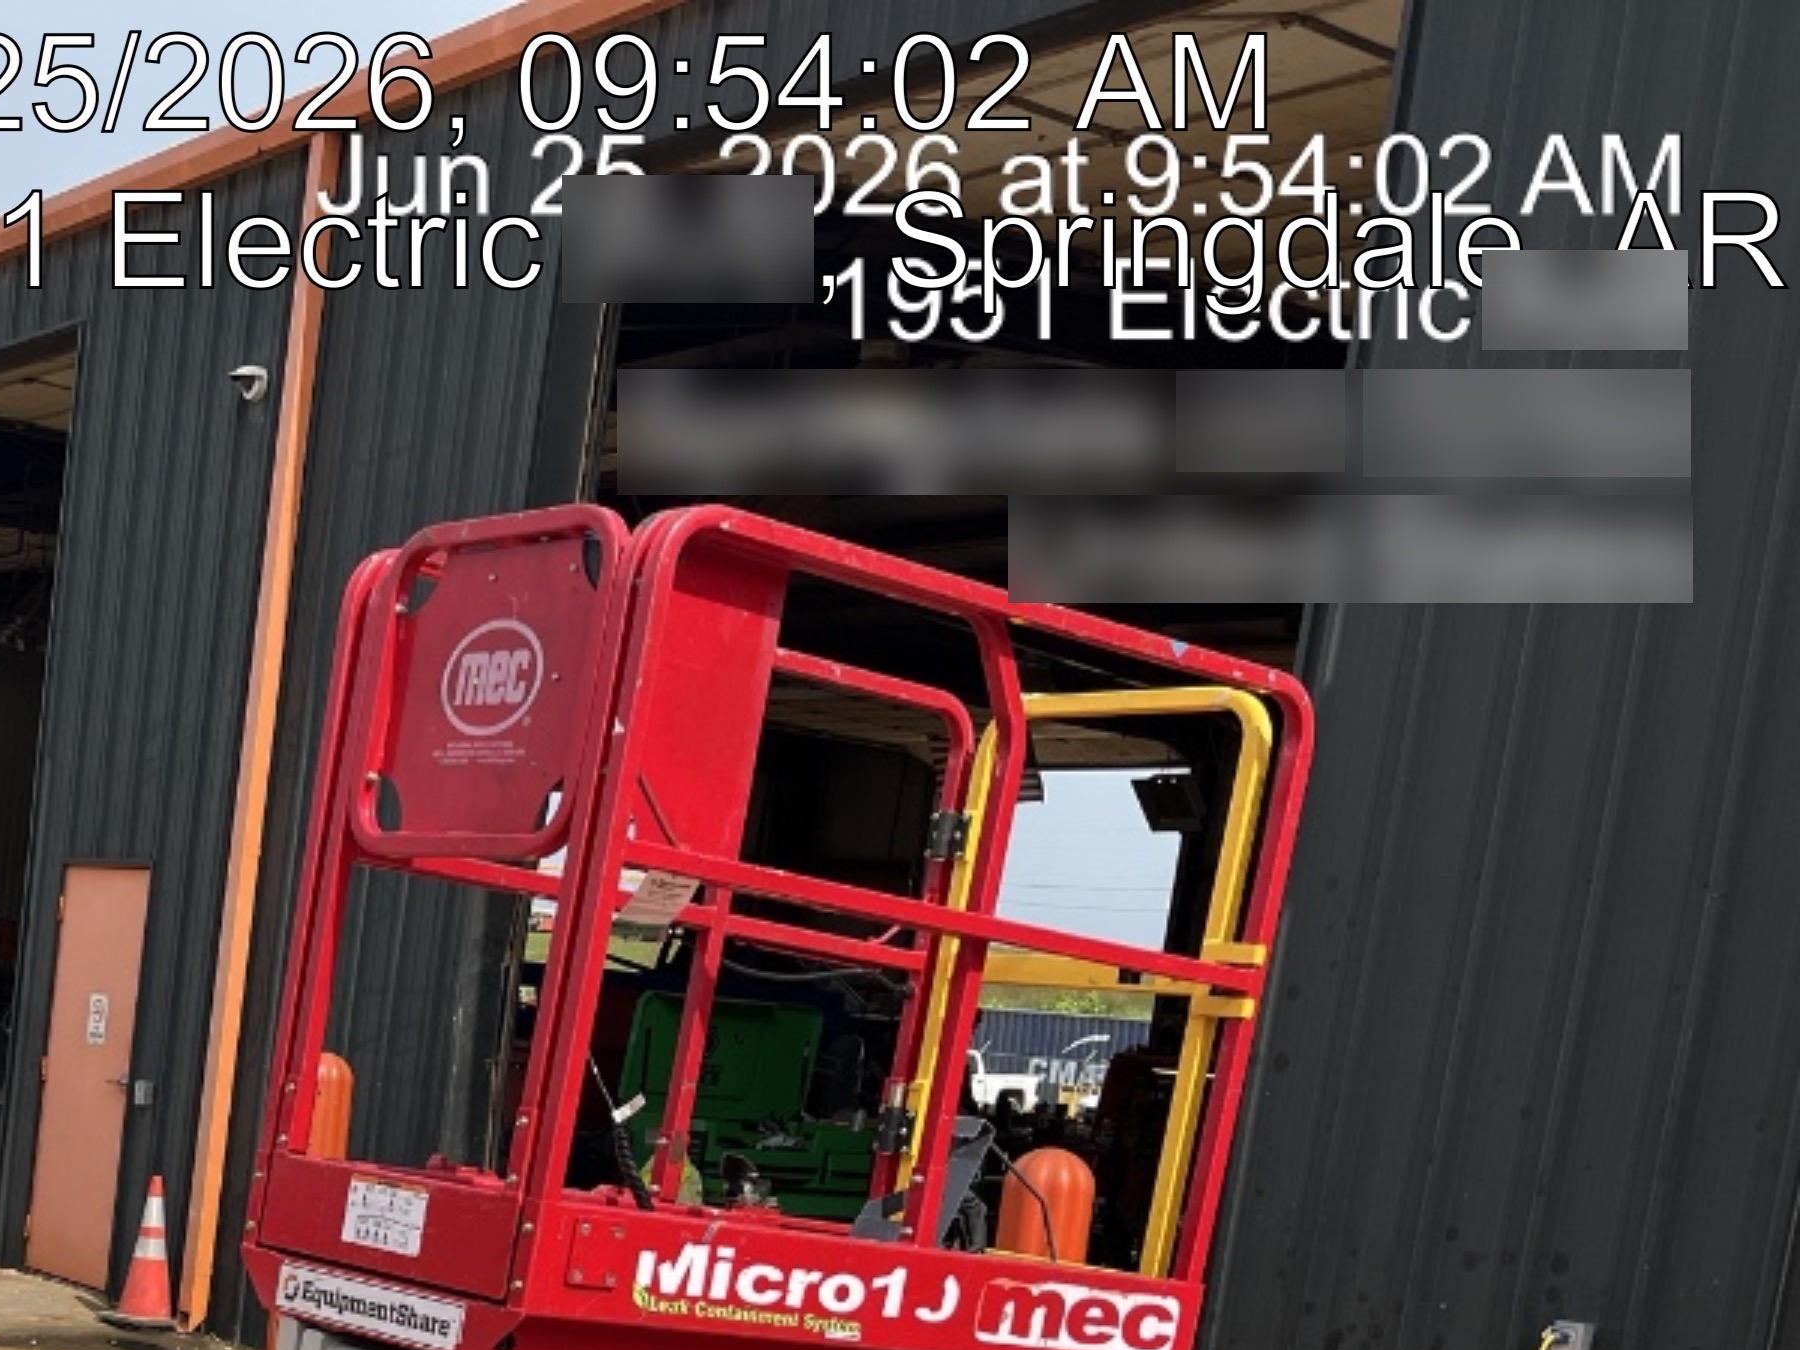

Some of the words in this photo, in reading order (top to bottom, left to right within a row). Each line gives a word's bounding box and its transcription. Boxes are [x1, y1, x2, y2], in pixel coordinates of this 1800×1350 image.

[453, 649, 531, 707] mec
[302, 1281, 450, 1338] EquipmentShare
[977, 1285, 1174, 1350] mec
